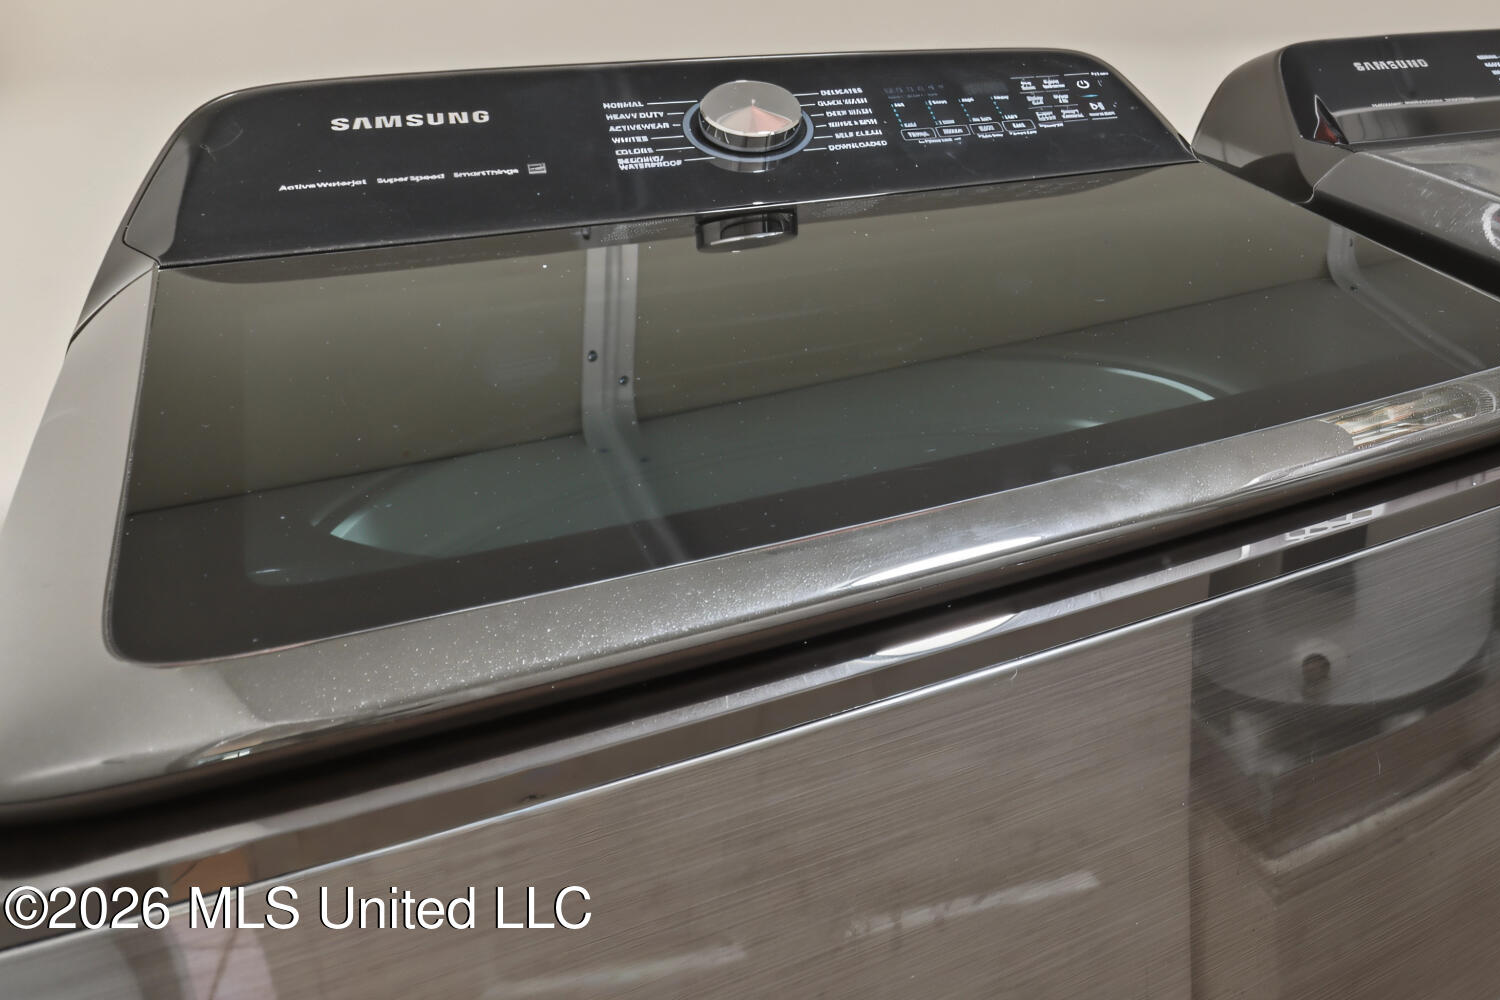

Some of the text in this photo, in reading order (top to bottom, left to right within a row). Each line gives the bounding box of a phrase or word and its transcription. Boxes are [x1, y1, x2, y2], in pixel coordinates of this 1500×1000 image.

[1353, 59, 1429, 72] SAMSUNG
[602, 101, 644, 110] NORMAL
[330, 110, 490, 132] SAMSUNG
[605, 111, 664, 121] HEAVY DUTY
[609, 122, 670, 132] ACTIVEWEAR
